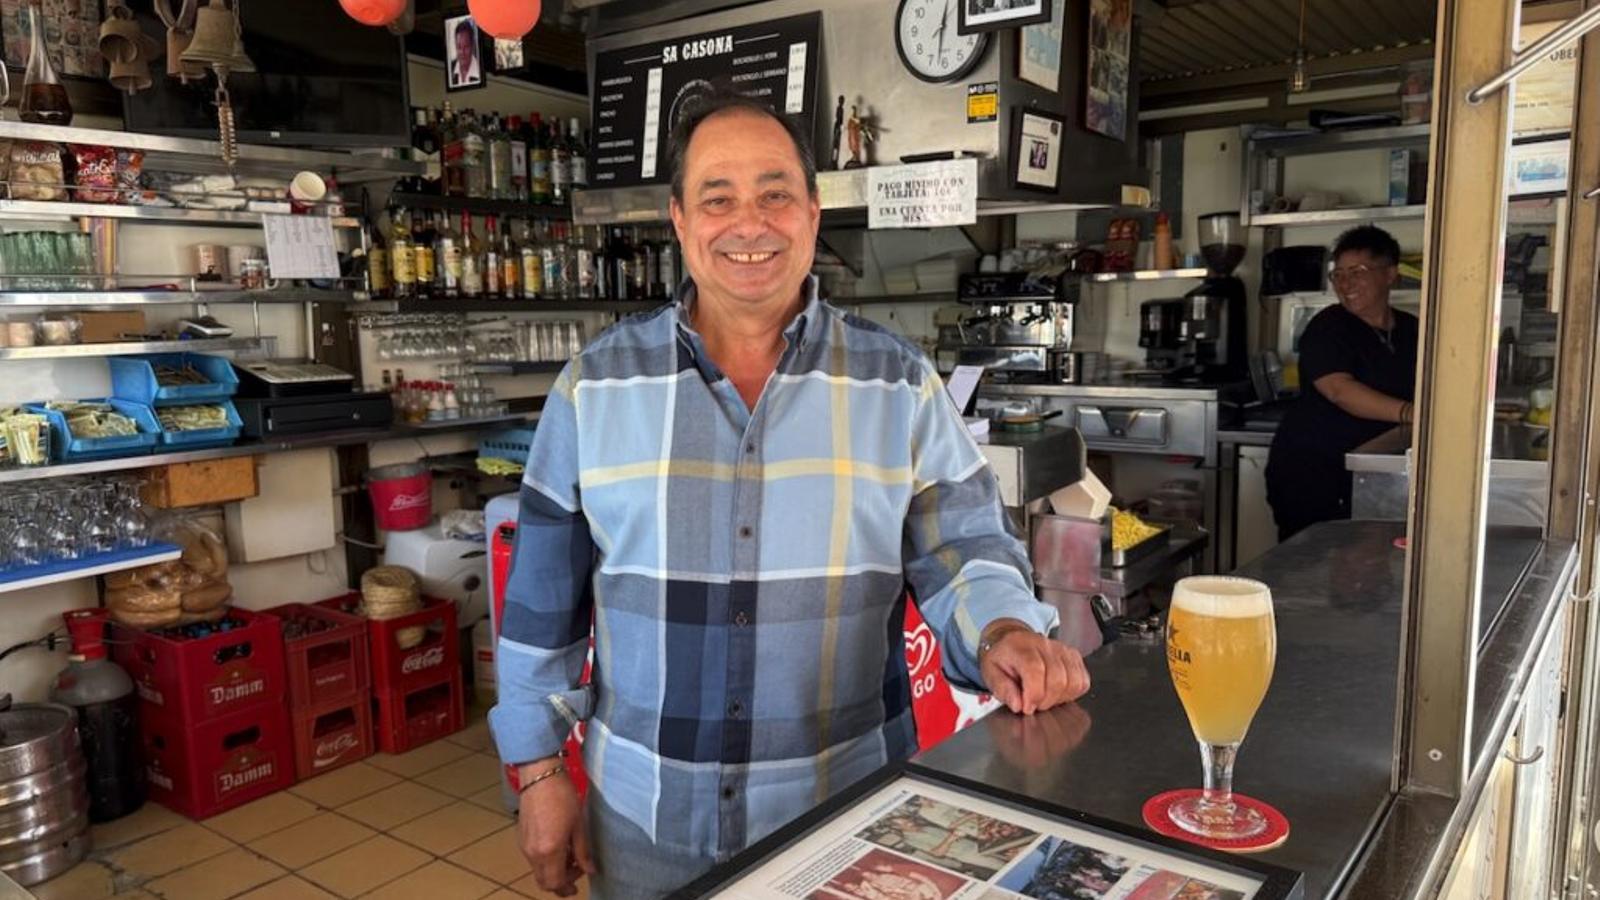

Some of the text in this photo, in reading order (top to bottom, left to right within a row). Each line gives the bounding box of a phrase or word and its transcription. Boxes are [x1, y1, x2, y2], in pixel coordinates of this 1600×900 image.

[914, 7, 925, 19] 10
[911, 26, 918, 37] 9
[663, 35, 733, 64] SA CASONA
[916, 43, 923, 55] 8
[956, 49, 963, 61] 5
[928, 54, 934, 66] 7
[941, 57, 948, 69] 6
[211, 680, 263, 704] Damm
[219, 763, 272, 791] Damm
